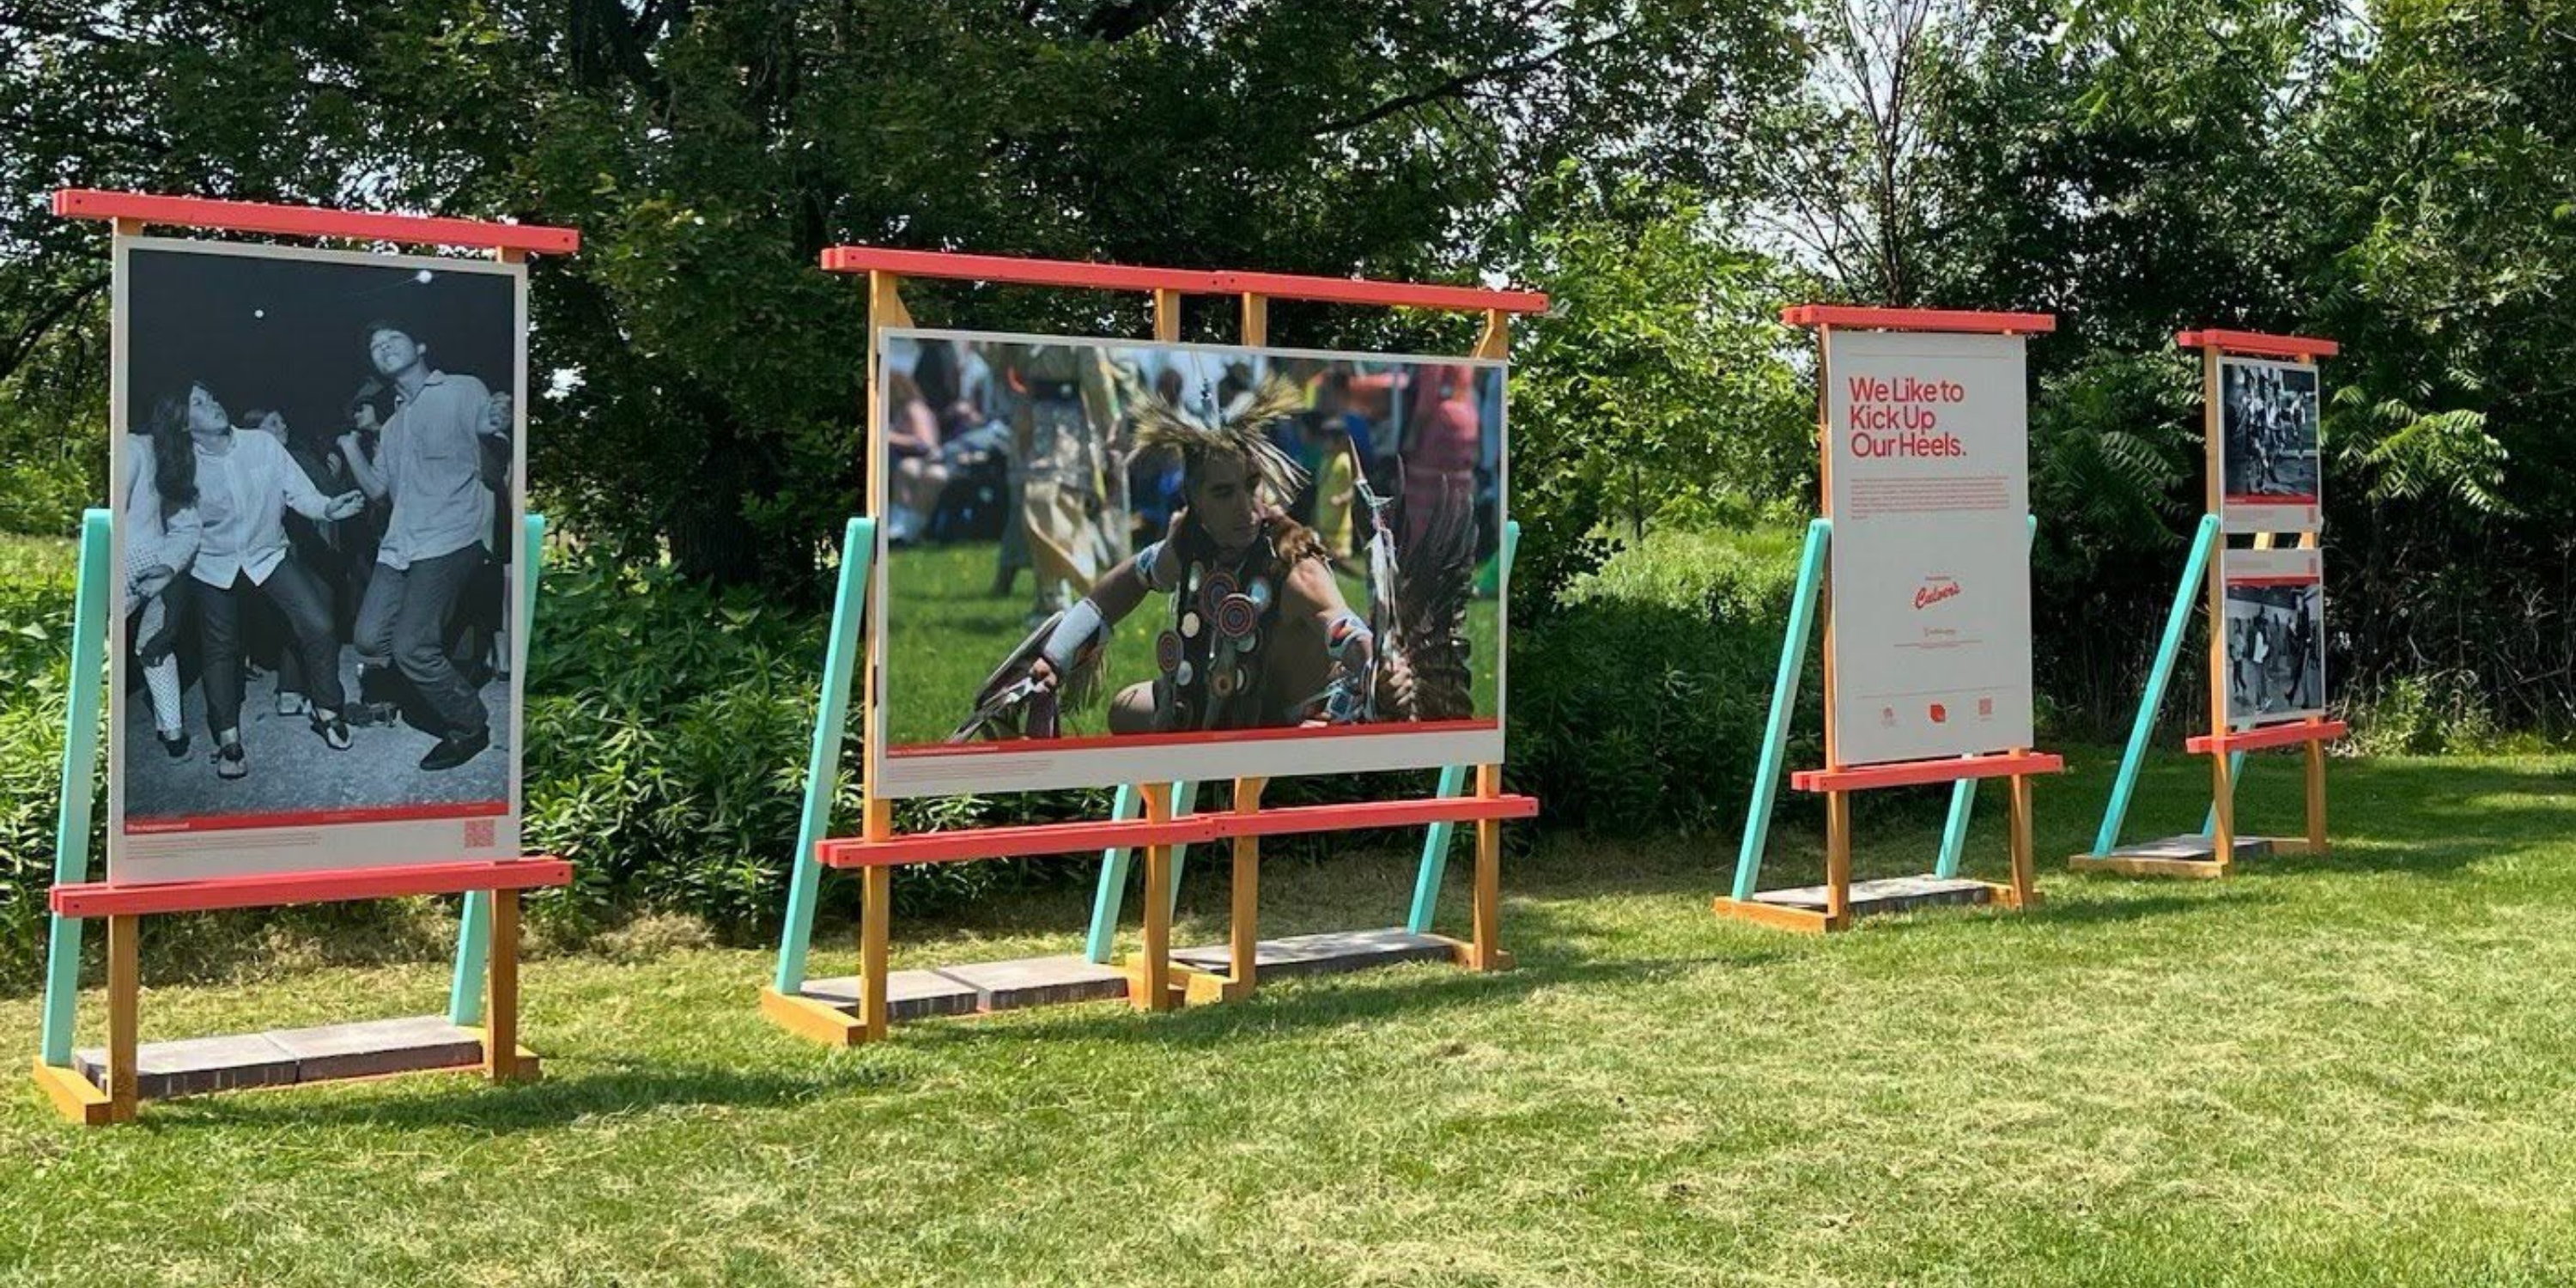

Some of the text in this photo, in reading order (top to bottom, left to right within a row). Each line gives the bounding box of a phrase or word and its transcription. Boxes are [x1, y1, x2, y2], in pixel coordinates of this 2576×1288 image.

[1850, 377, 1965, 403] We Like to
[1850, 404, 1936, 435] Kick Up
[1851, 431, 1967, 458] Our Heels.
